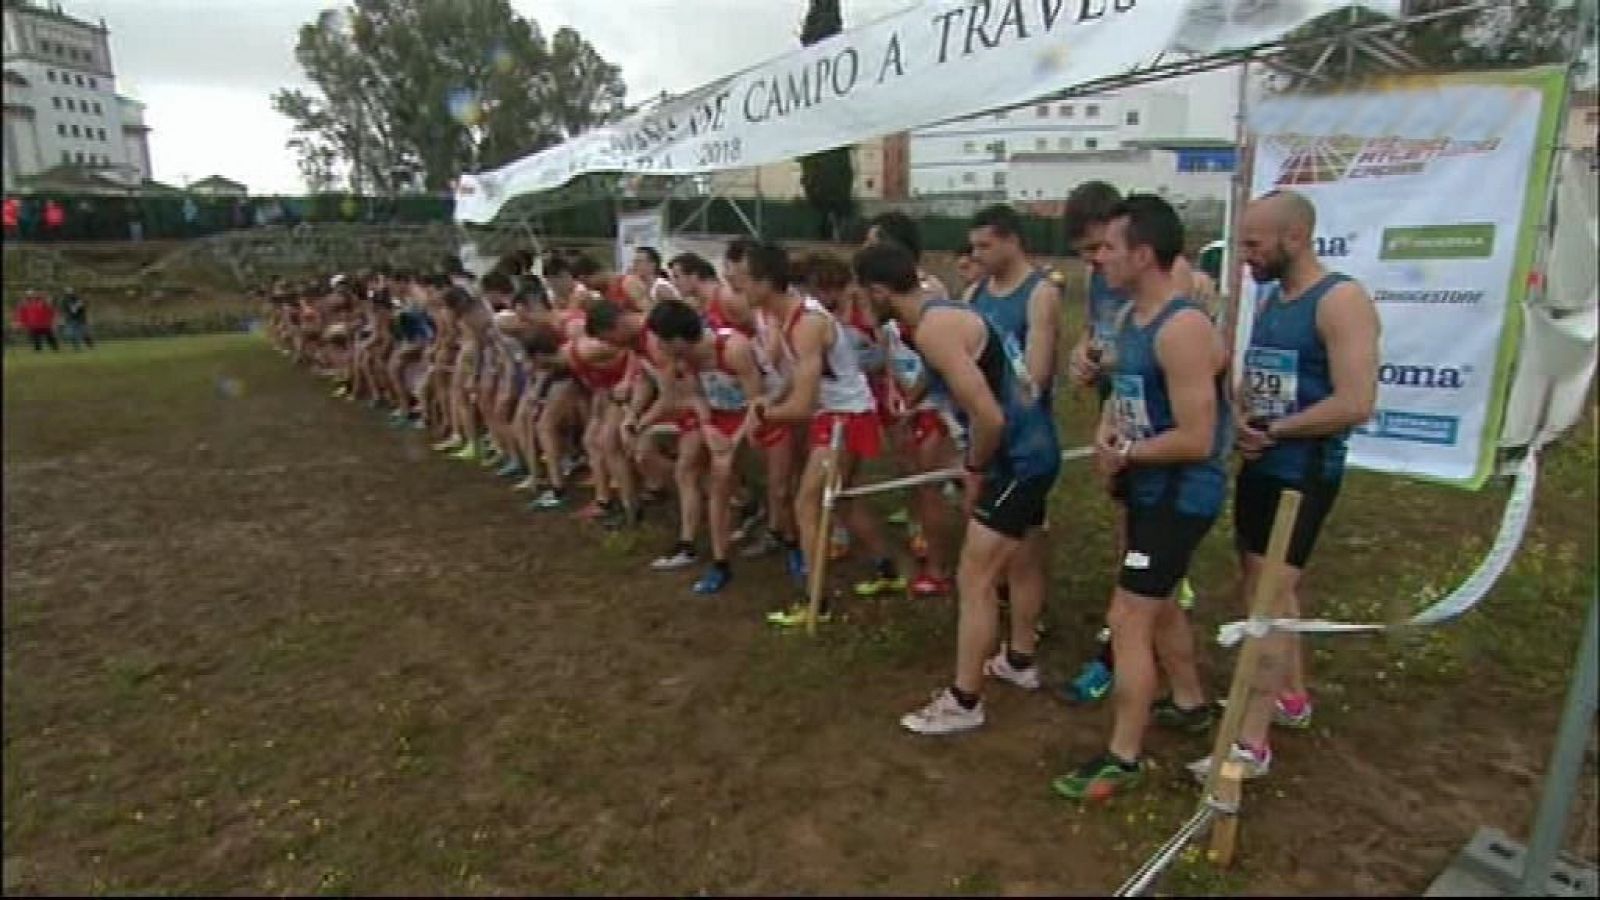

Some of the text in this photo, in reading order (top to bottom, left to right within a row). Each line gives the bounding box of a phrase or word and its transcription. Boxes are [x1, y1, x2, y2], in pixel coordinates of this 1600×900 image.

[743, 48, 859, 123] CAMPO
[878, 33, 907, 84] A
[933, 0, 1137, 65] TRAV
[1249, 371, 1282, 395] 29
[1378, 363, 1465, 389] oma
